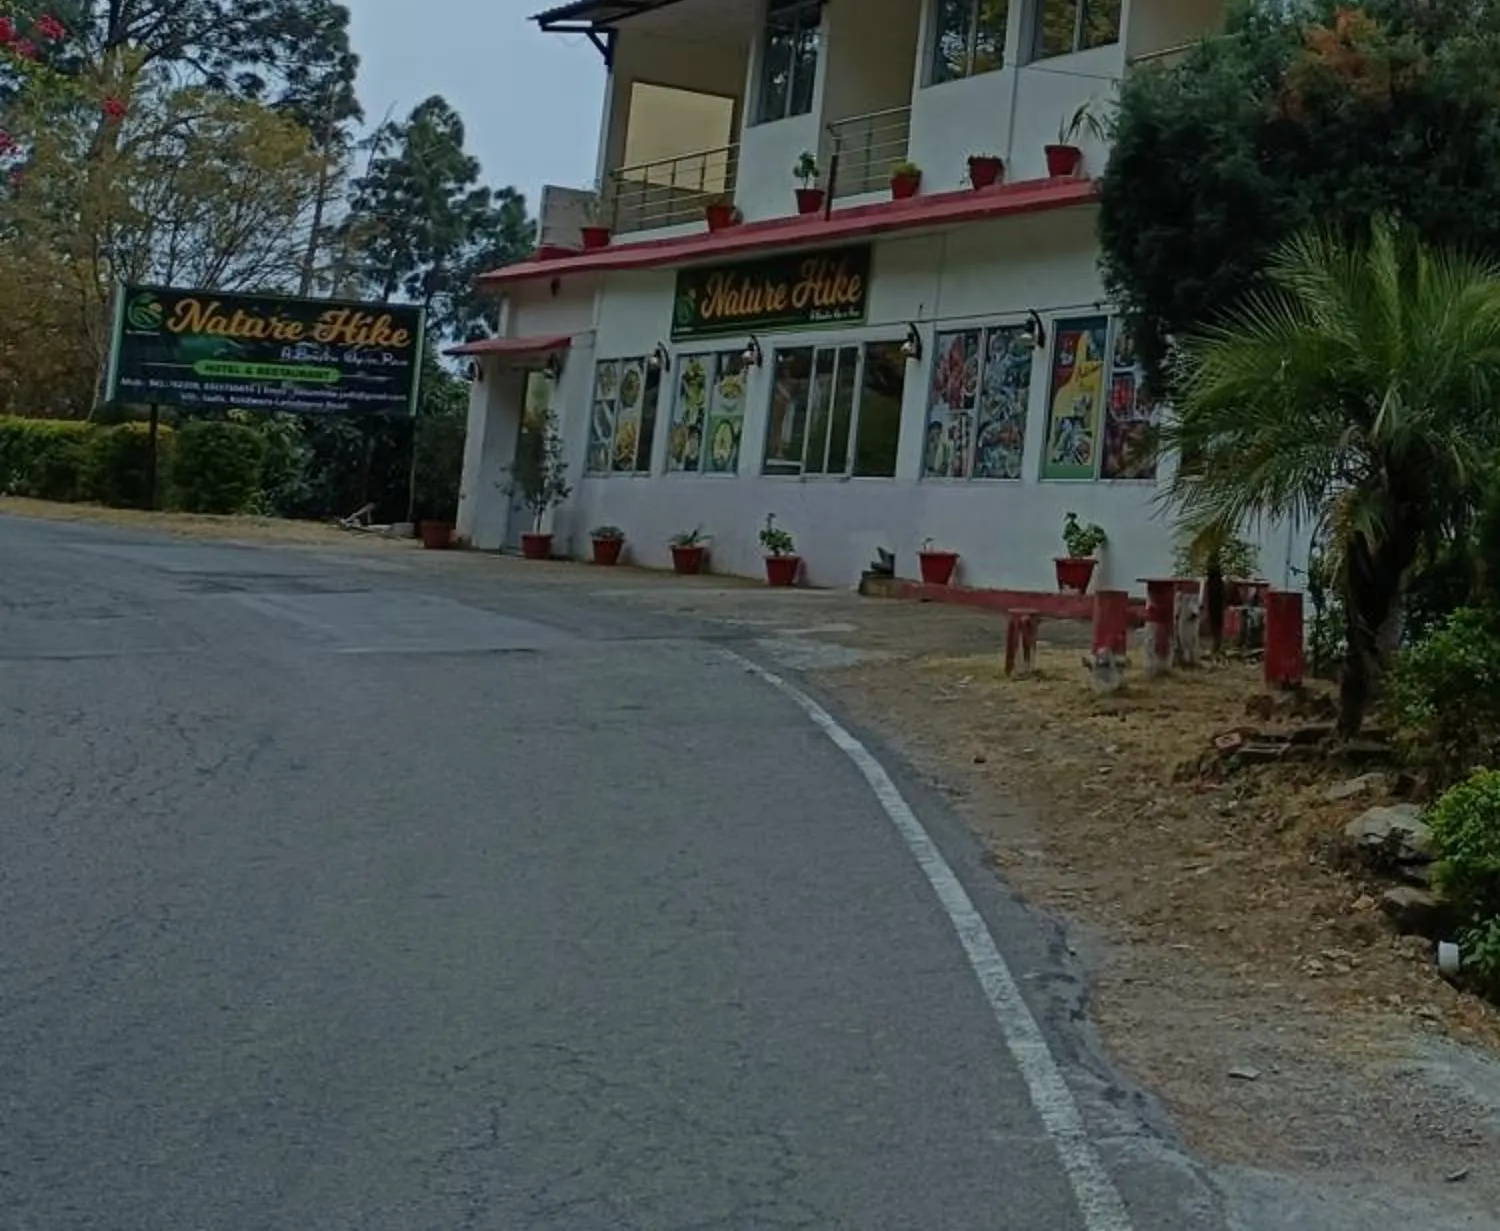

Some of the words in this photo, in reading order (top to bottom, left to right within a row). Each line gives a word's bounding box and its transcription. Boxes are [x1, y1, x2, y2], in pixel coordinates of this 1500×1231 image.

[699, 271, 787, 318] Nature
[791, 258, 863, 309] Hike
[166, 297, 304, 342] Nature
[312, 310, 412, 349] Hike
